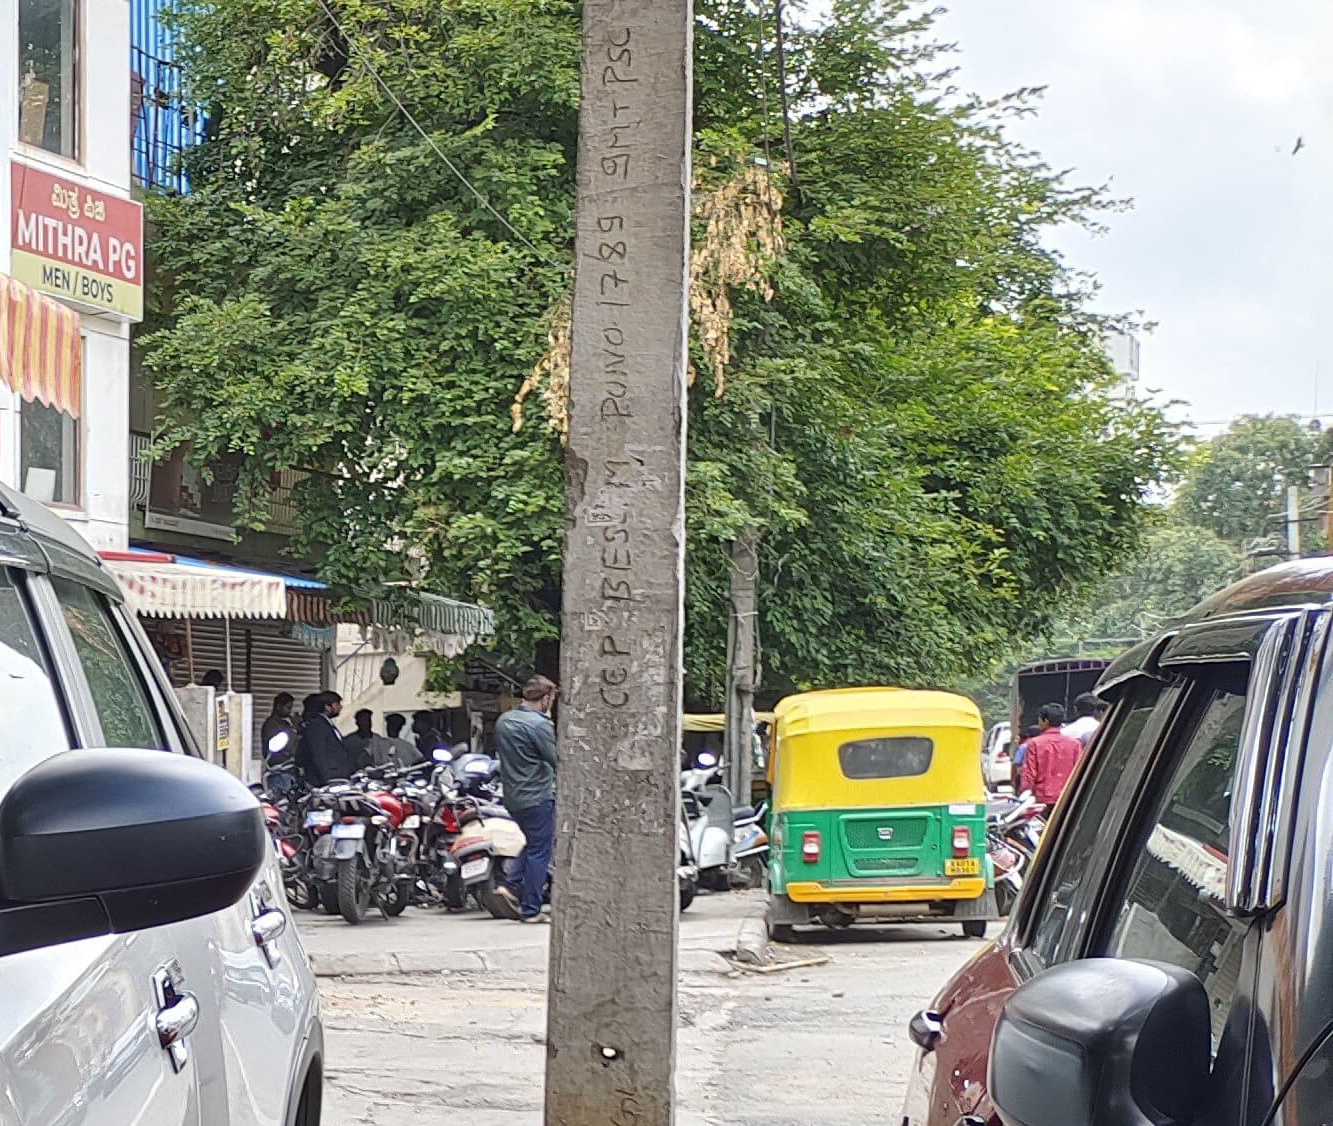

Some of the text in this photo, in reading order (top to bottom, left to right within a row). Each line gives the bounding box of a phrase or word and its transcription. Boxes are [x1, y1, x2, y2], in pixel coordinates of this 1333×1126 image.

[17, 210, 136, 279] MITHRA PG
[43, 264, 70, 292] MEN
[82, 276, 114, 303] BOYS
